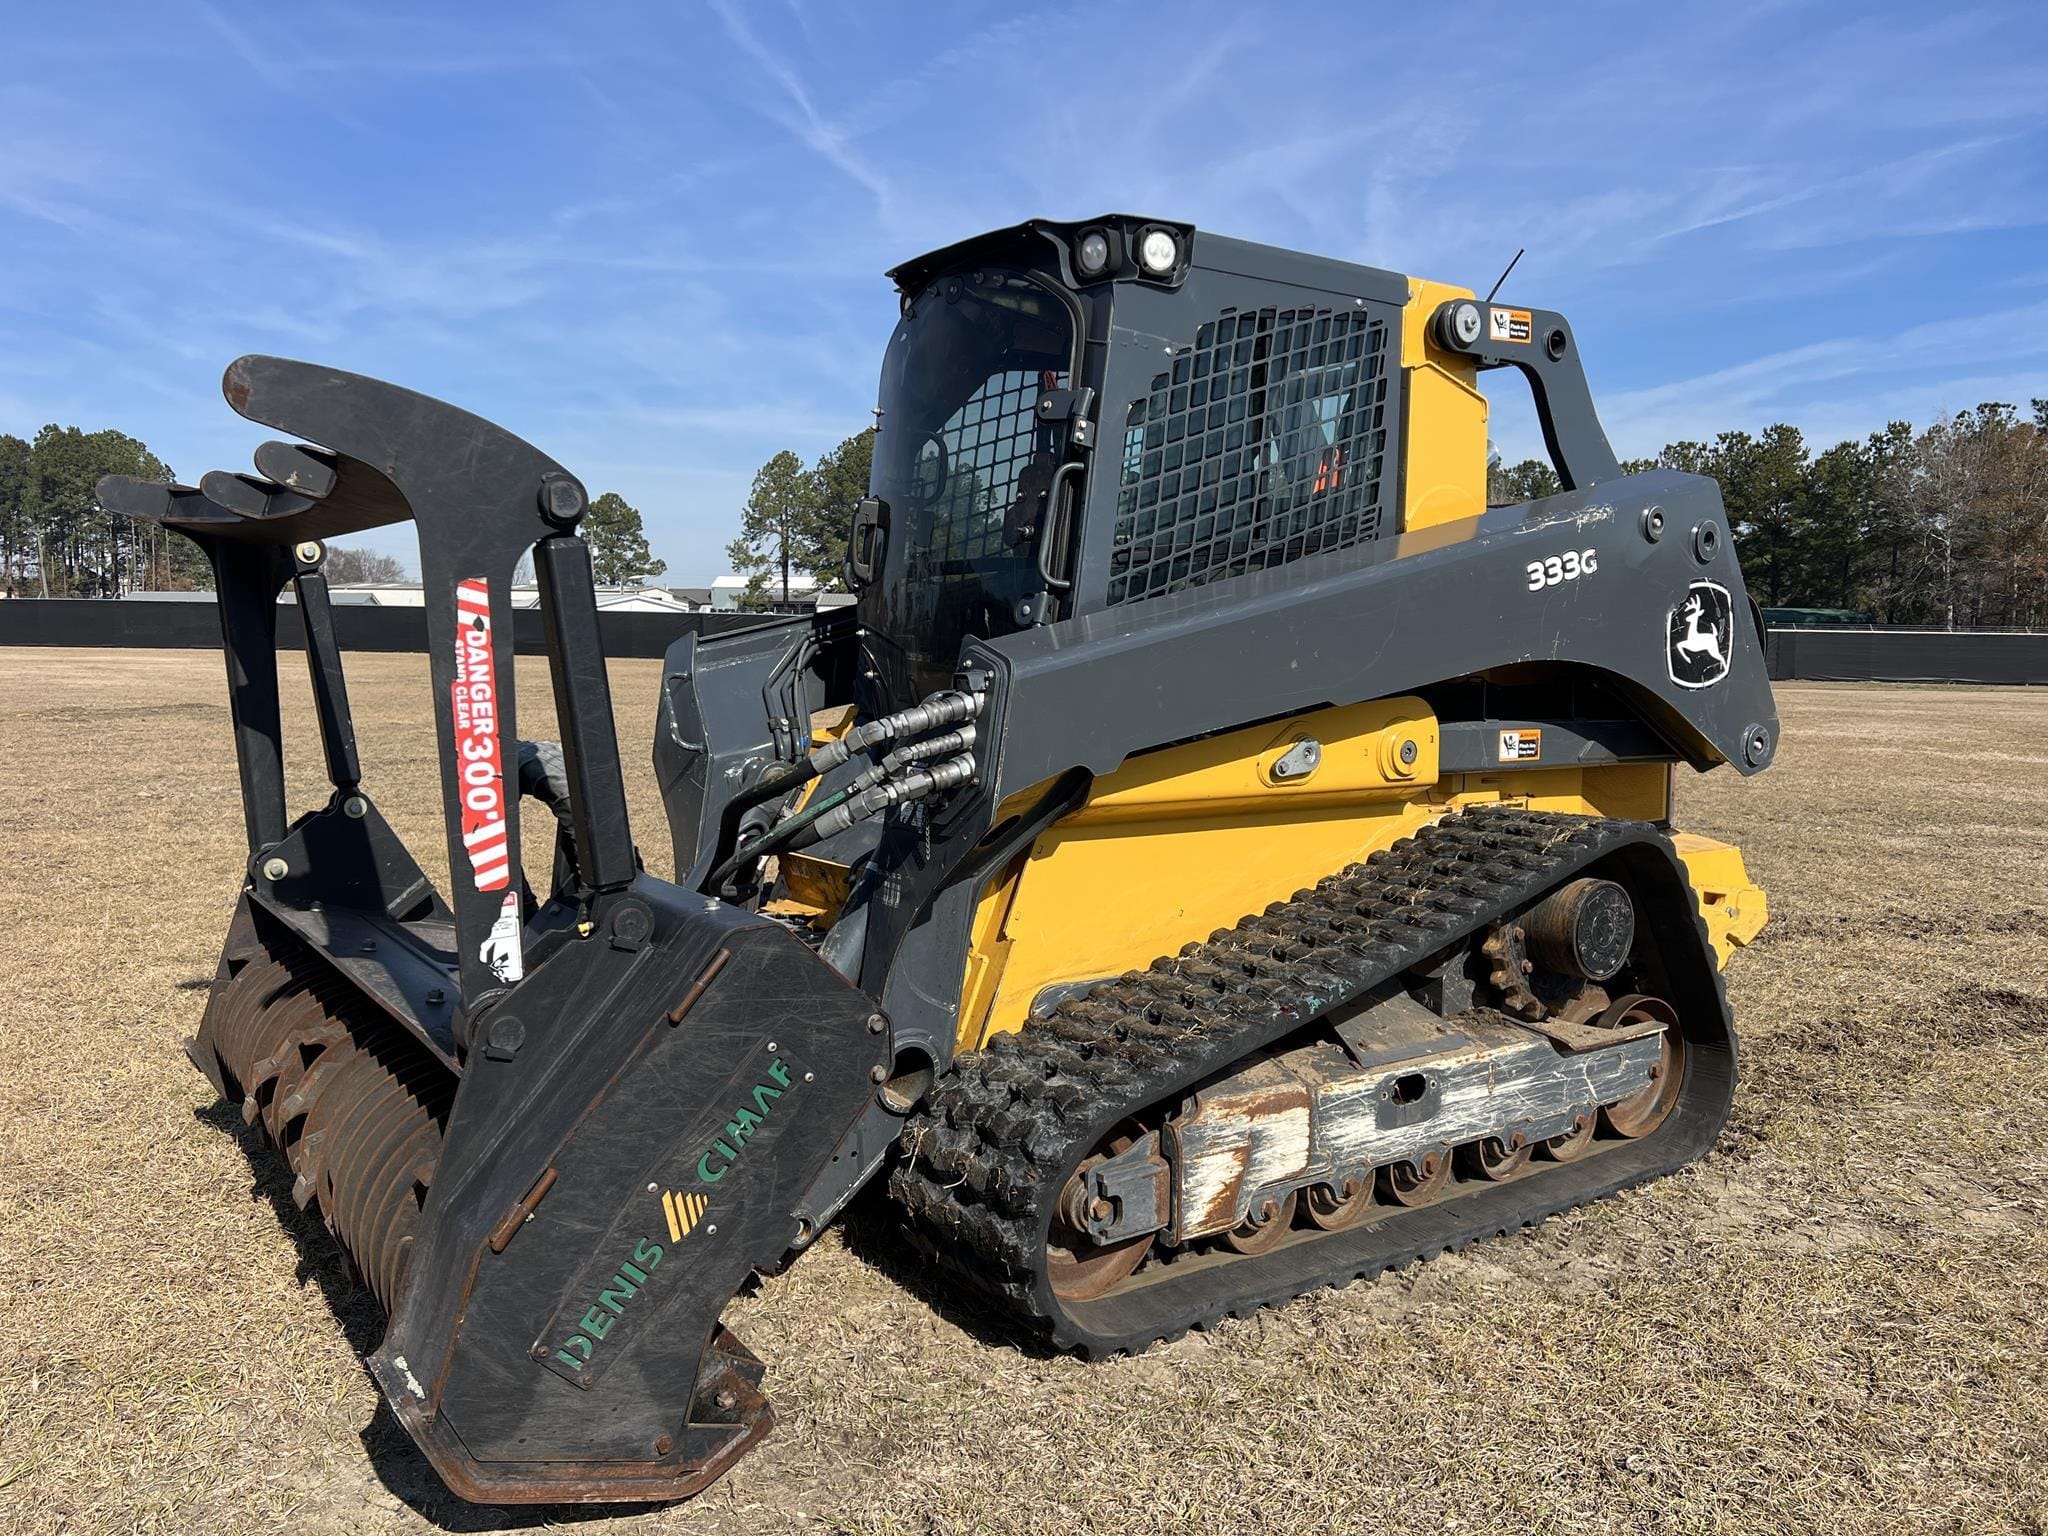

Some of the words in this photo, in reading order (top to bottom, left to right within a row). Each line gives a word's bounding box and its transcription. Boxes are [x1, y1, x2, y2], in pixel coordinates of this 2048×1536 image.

[1527, 548, 1598, 592] 333G
[455, 639, 467, 683] STAND
[465, 630, 494, 737] DANGER
[455, 686, 471, 730] CLEAR
[554, 1235, 665, 1371] DENIS
[696, 1056, 793, 1183] CIMAF
